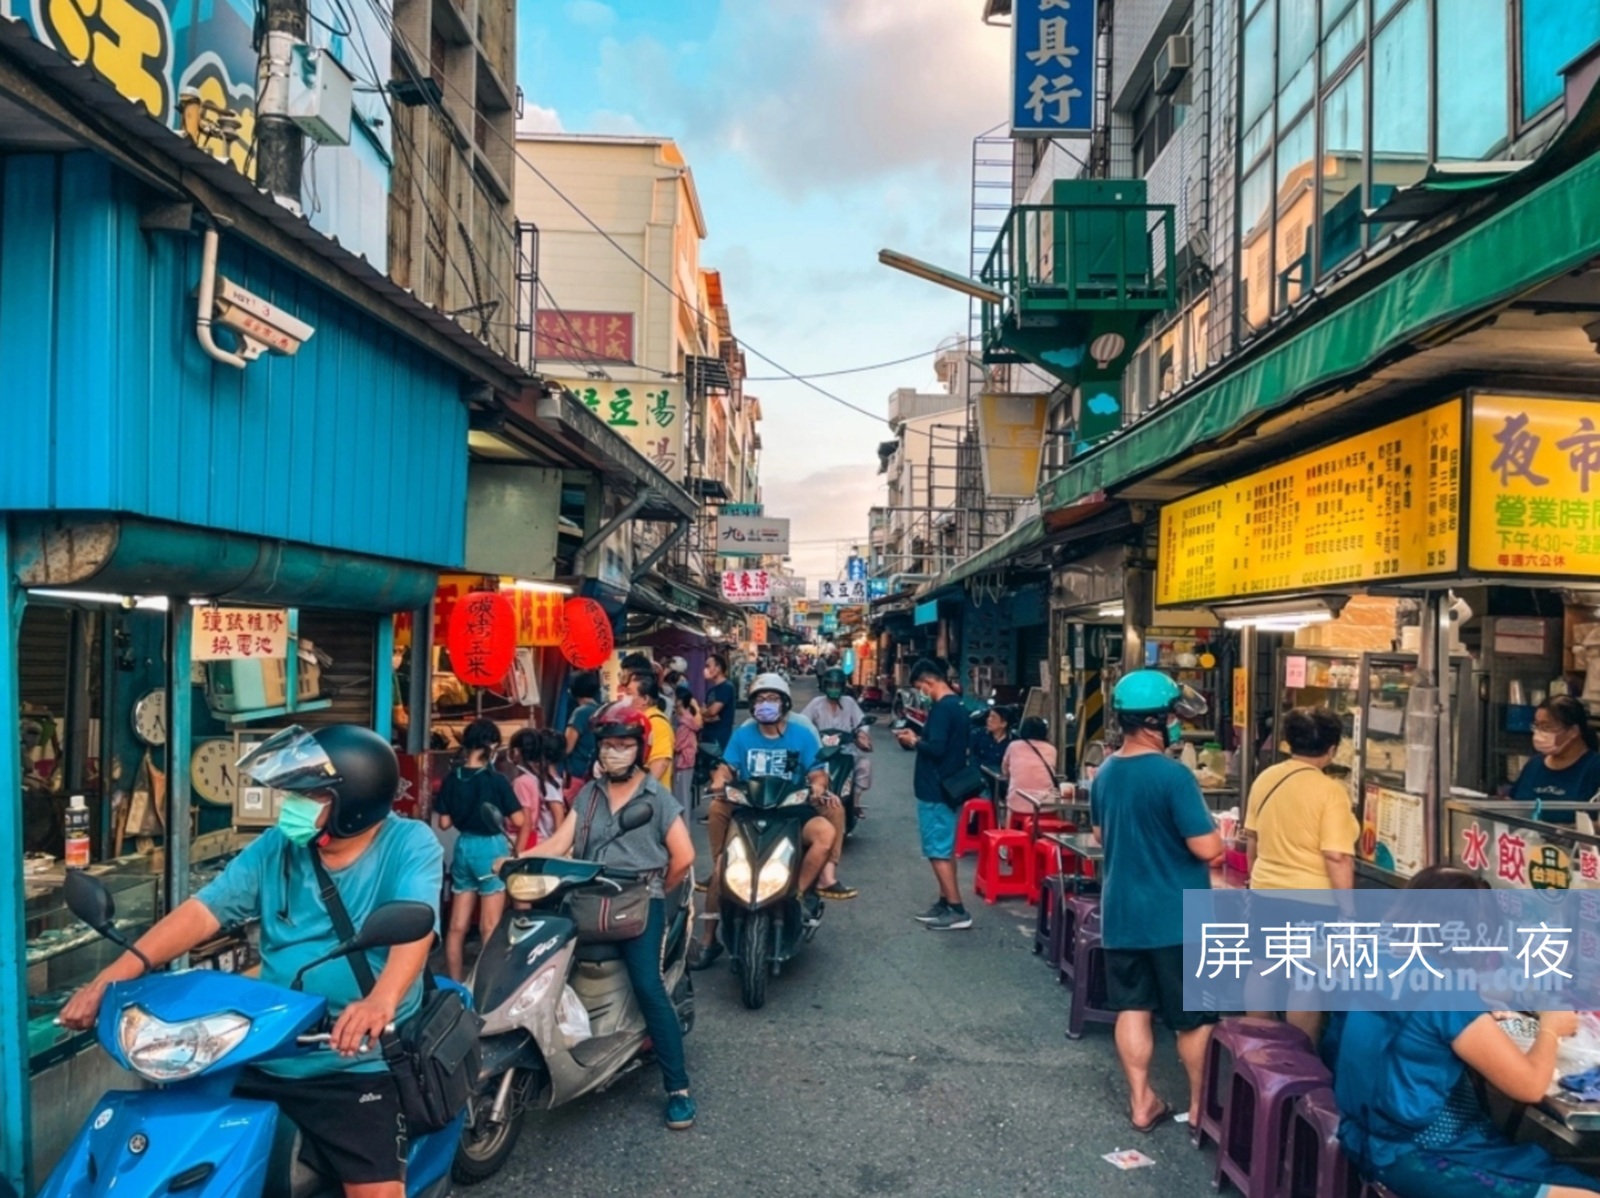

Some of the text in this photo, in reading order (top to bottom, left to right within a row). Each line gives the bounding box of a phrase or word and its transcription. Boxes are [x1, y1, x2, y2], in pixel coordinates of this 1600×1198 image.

[1024, 0, 1082, 124] 具行
[1495, 494, 1600, 530] 營業時
[1498, 554, 1566, 568] 每週六公休
[822, 581, 865, 599] 臭豆腐
[202, 611, 283, 632] 鐘錶維修
[212, 634, 273, 656] 換電池
[1462, 823, 1527, 885] 水餃
